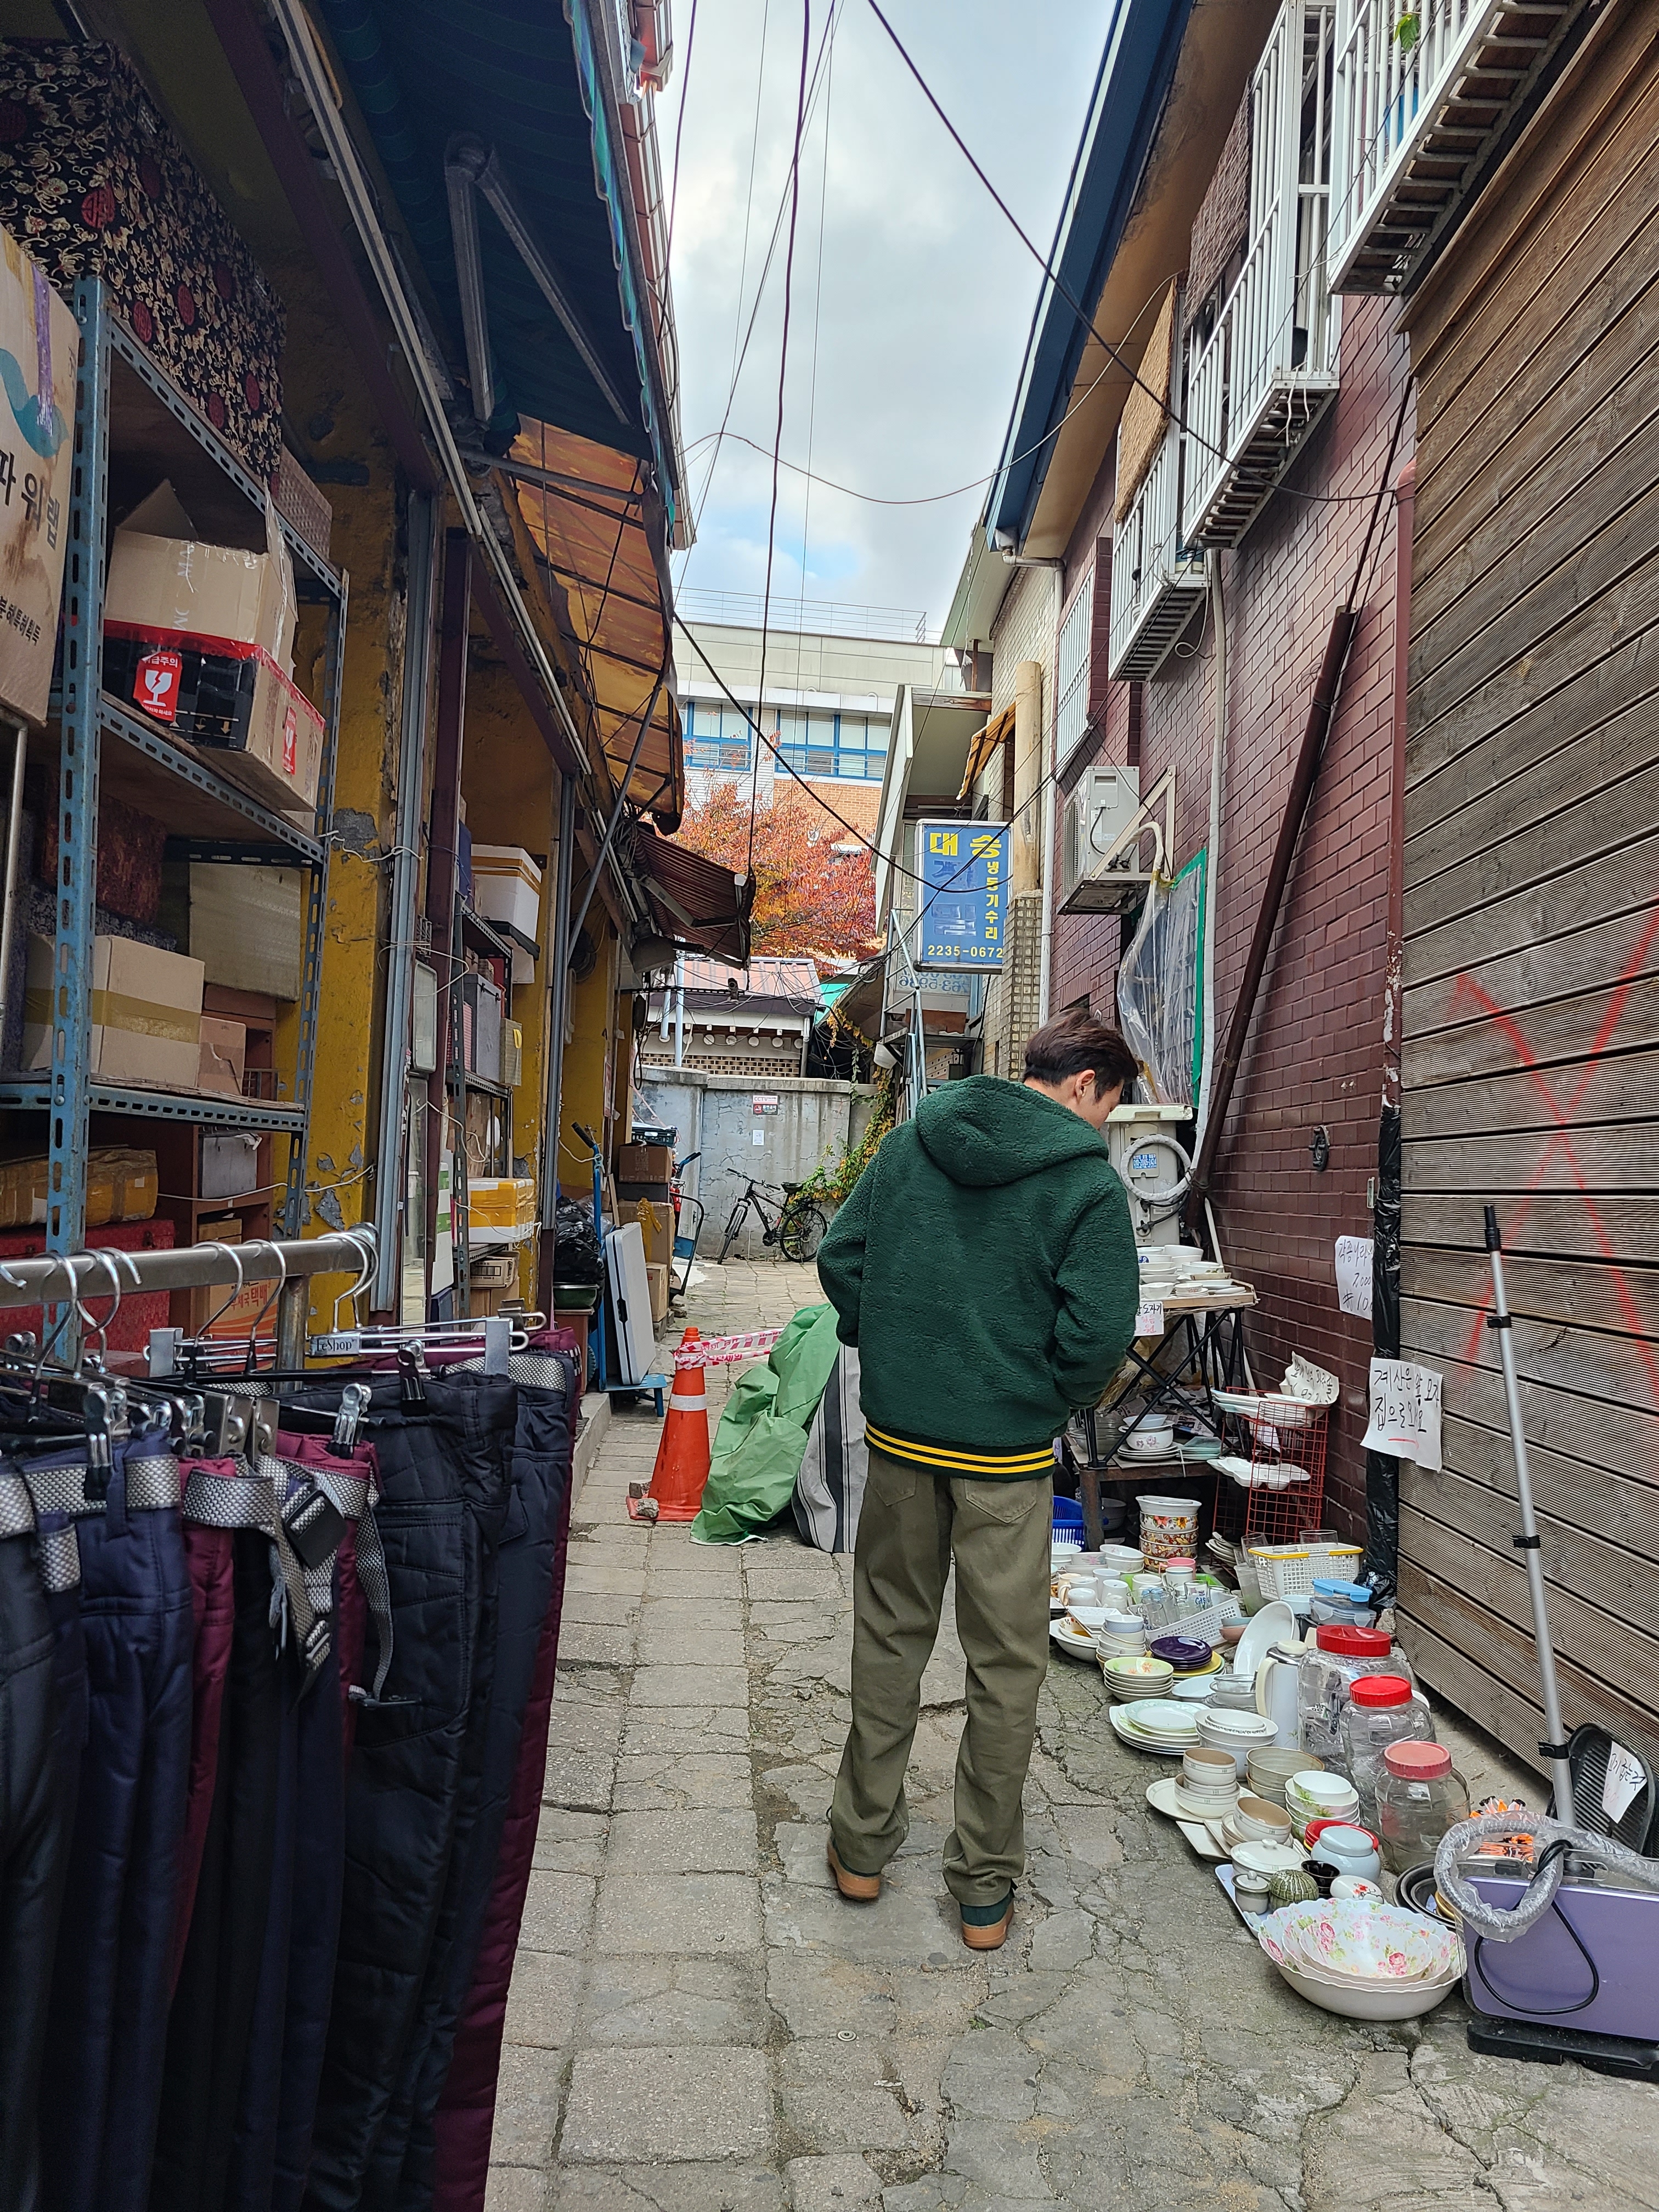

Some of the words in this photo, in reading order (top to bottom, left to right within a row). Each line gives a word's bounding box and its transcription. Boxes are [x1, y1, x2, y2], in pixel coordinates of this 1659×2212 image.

[985, 861, 1000, 940] 냉동기수리
[928, 945, 1003, 958] 2235-0672
[1374, 1365, 1412, 1392] 계산은
